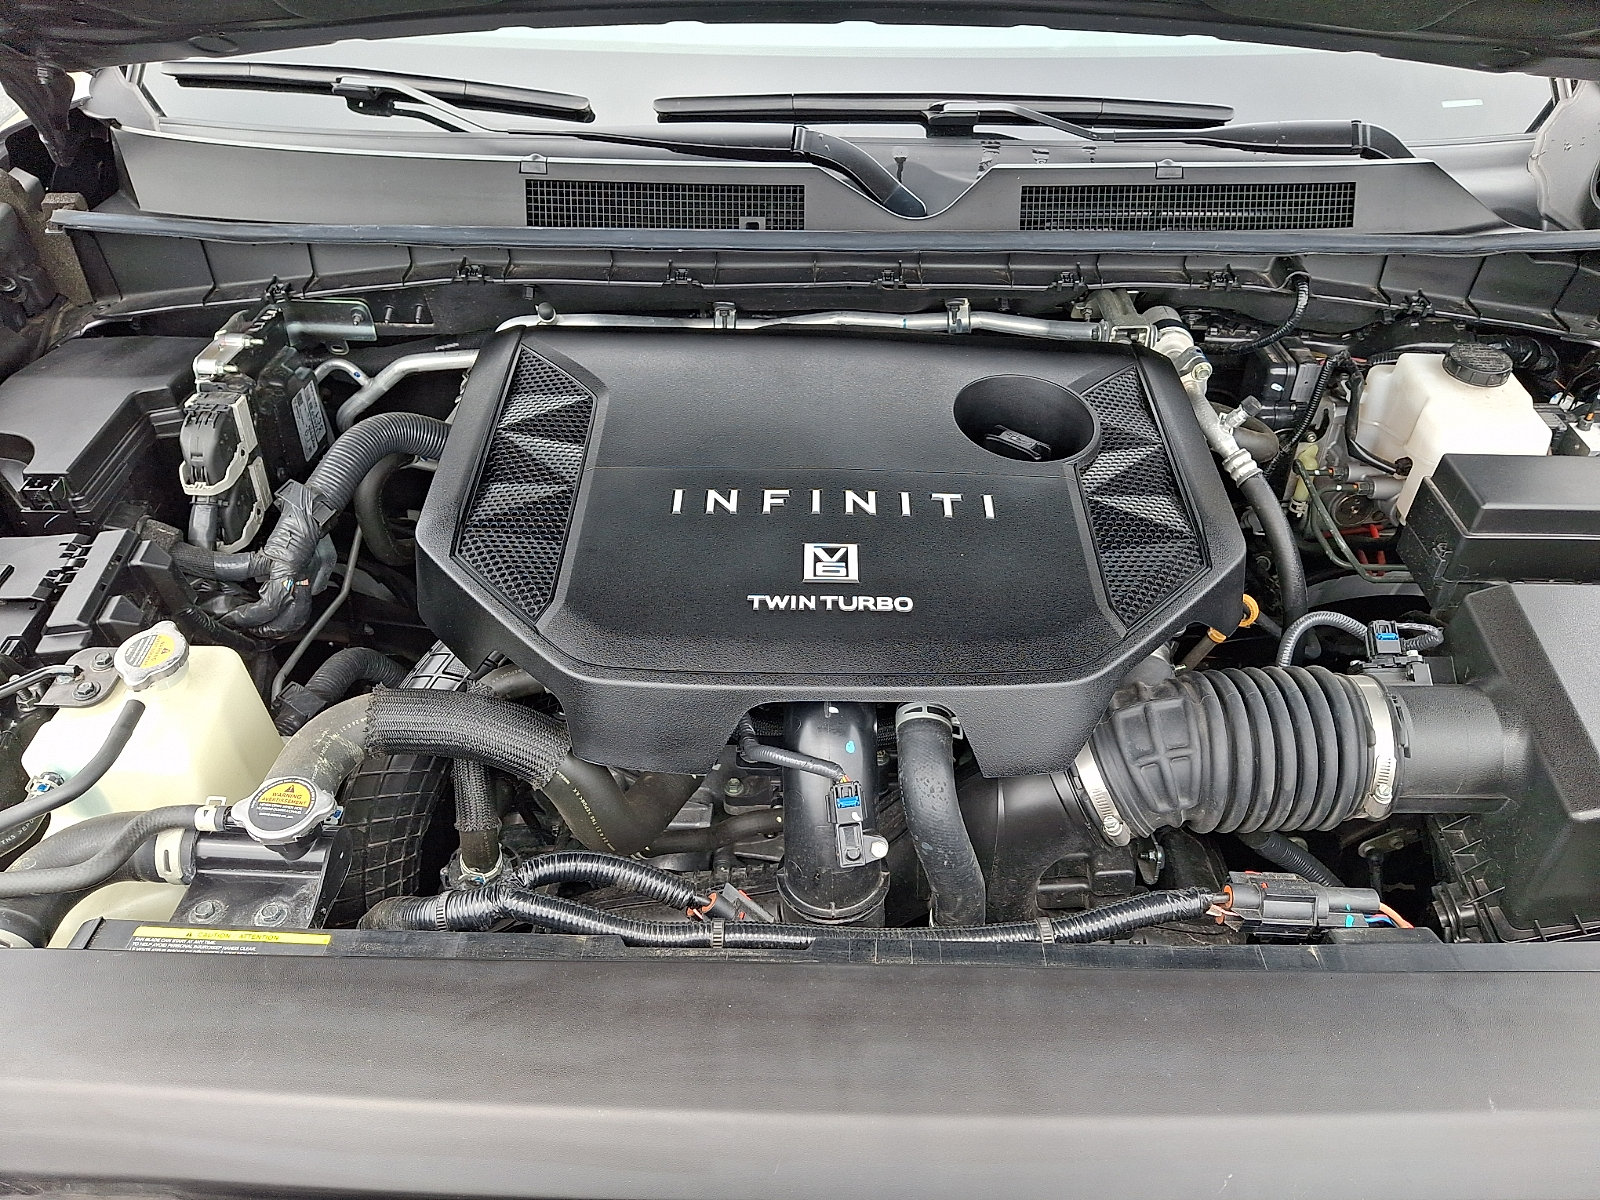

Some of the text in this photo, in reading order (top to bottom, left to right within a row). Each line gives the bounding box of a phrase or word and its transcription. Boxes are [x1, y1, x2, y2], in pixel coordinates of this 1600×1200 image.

[671, 488, 996, 519] INFINITI
[747, 594, 914, 612] TWIN TURBO
[272, 792, 303, 800] WARNING
[197, 931, 280, 941] CAUTION ATTENTION
